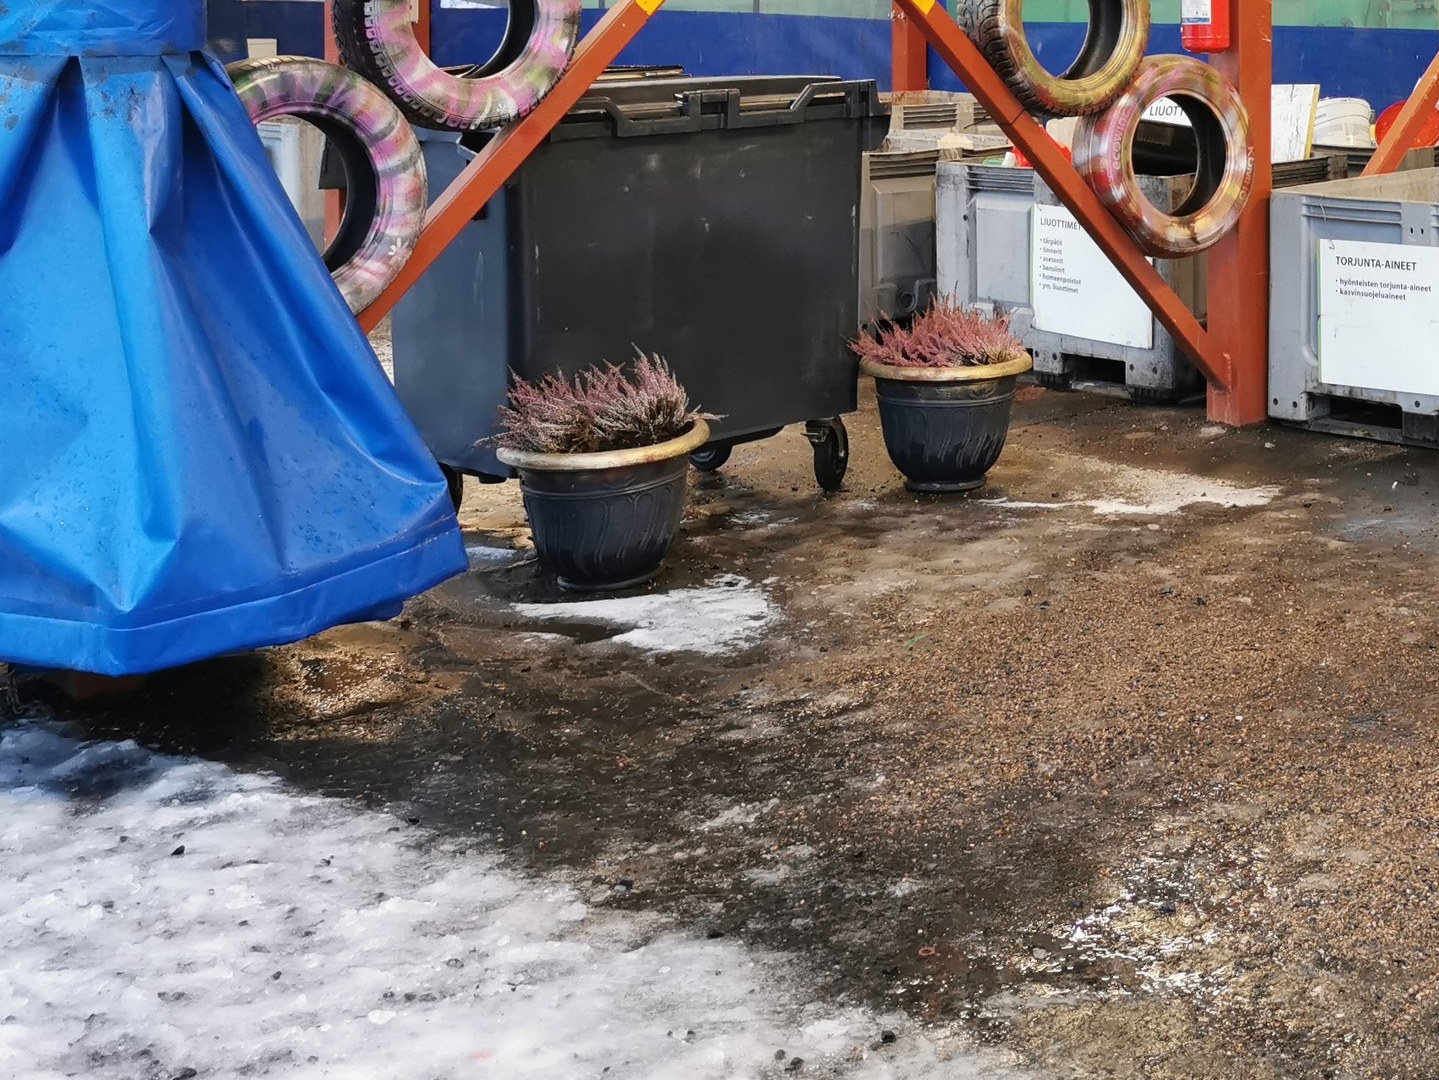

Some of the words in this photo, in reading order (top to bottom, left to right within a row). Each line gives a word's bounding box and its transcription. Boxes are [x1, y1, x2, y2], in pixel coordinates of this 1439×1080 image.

[1149, 105, 1183, 116] LIUOT
[1335, 256, 1417, 271] TORJUNTA-AINEET
[1339, 278, 1378, 288] hyönteisten
[1380, 281, 1432, 292] torjunta-aineet
[1339, 287, 1406, 301] kasvinsuojeluaineet
